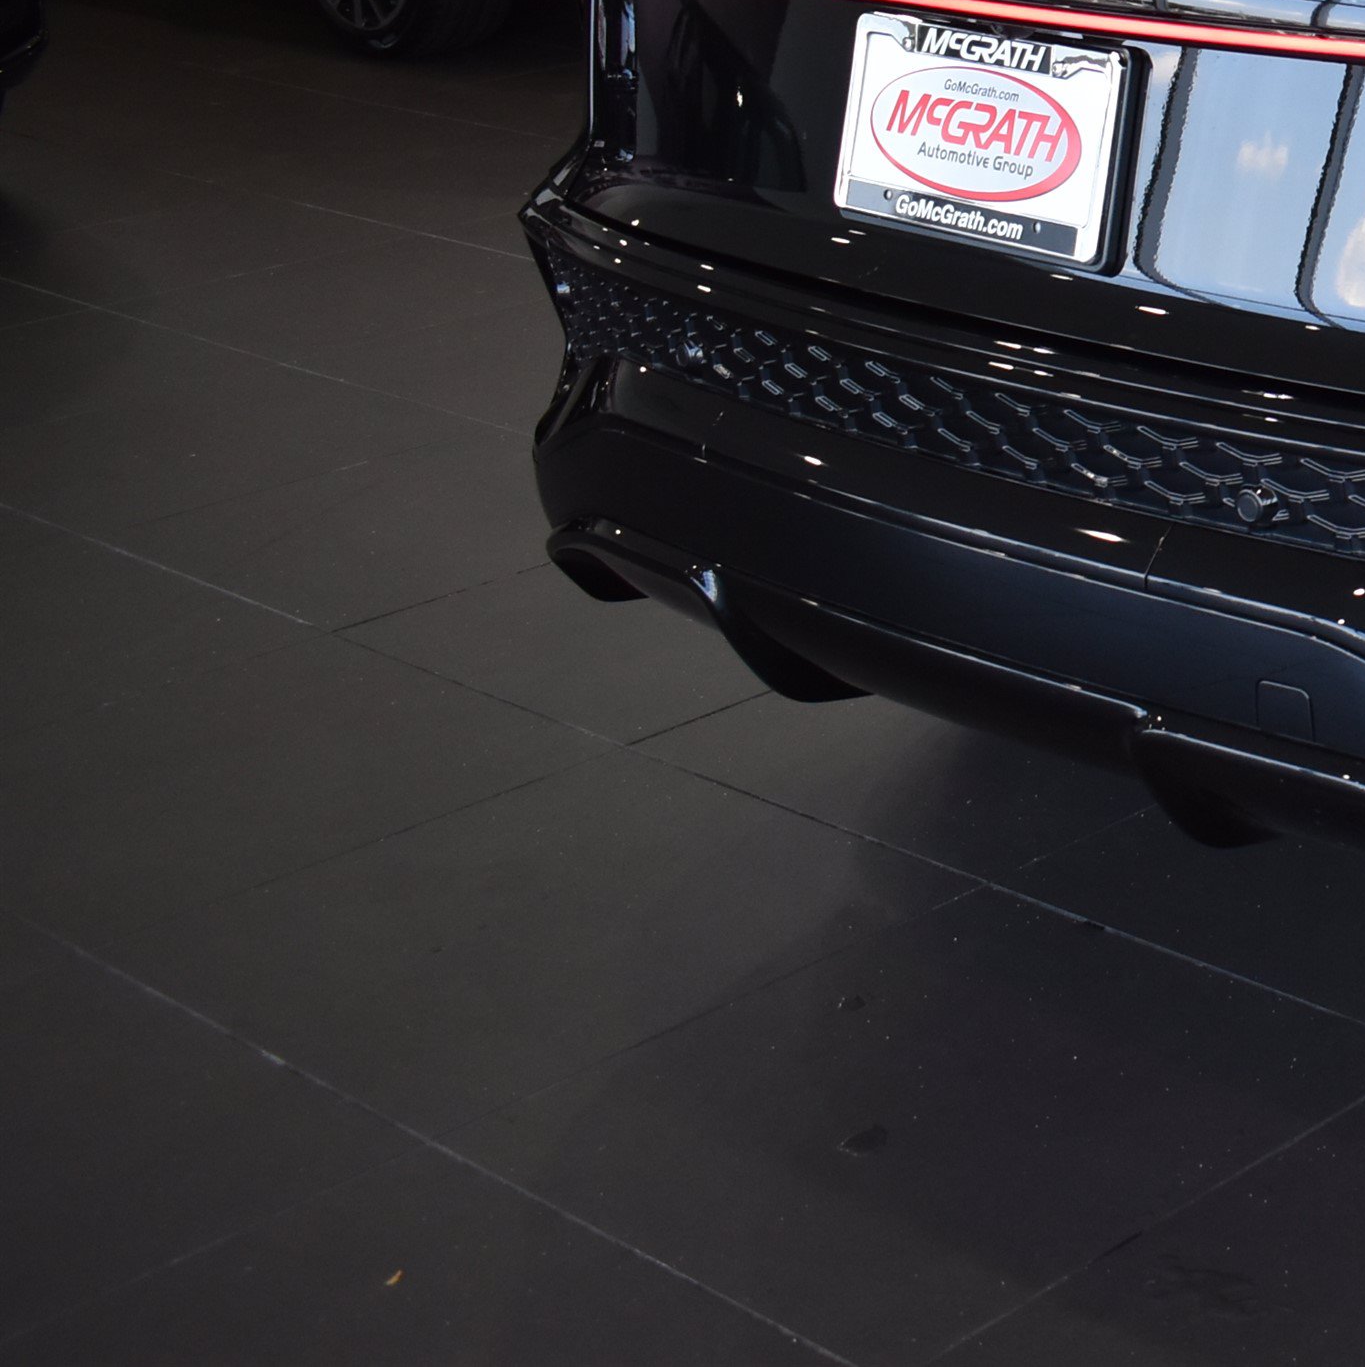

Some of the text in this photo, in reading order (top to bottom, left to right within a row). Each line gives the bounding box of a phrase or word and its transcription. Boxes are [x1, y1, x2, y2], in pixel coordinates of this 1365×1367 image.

[944, 79, 1020, 103] GoMcGrath.com
[917, 141, 1035, 180] Automotive Group
[895, 194, 1024, 240] GoMcGrath.com
